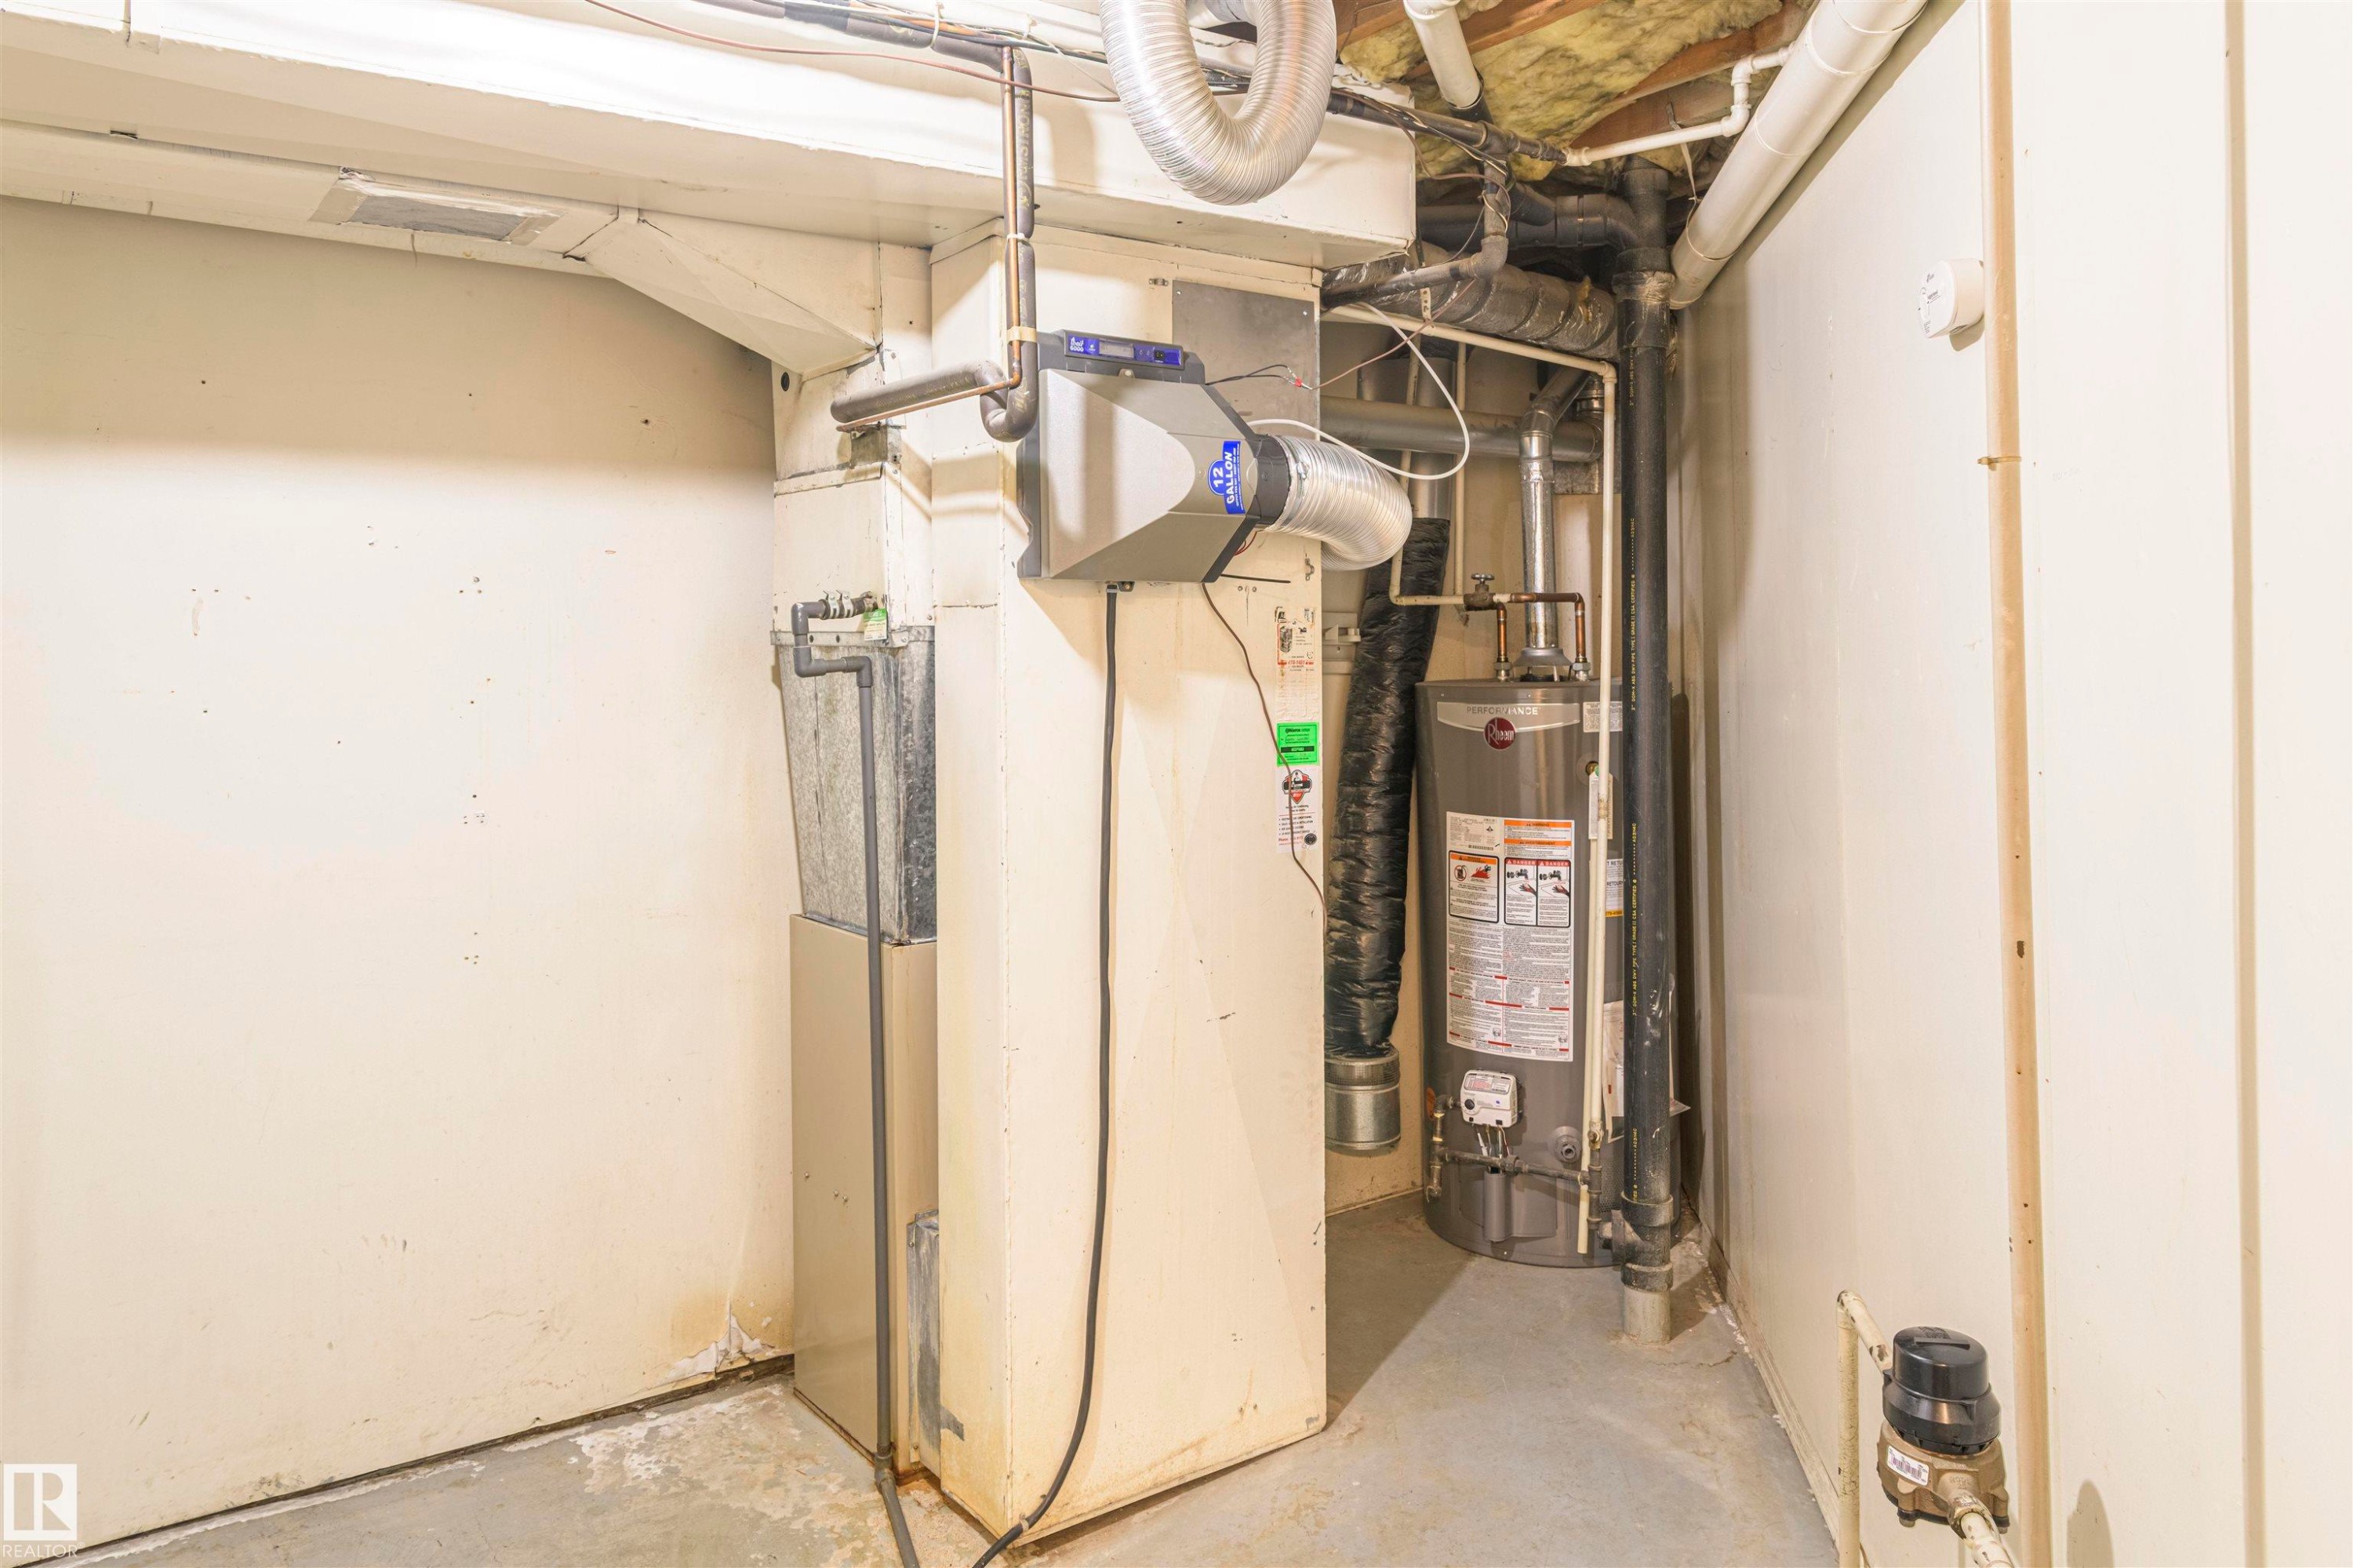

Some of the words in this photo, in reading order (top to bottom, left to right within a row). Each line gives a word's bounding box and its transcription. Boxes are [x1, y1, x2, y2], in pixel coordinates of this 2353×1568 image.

[1213, 467, 1224, 487] 12
[1224, 451, 1235, 504] GALLON
[1466, 706, 1538, 715] PERFORMANCE
[1487, 718, 1515, 746] Rheem
